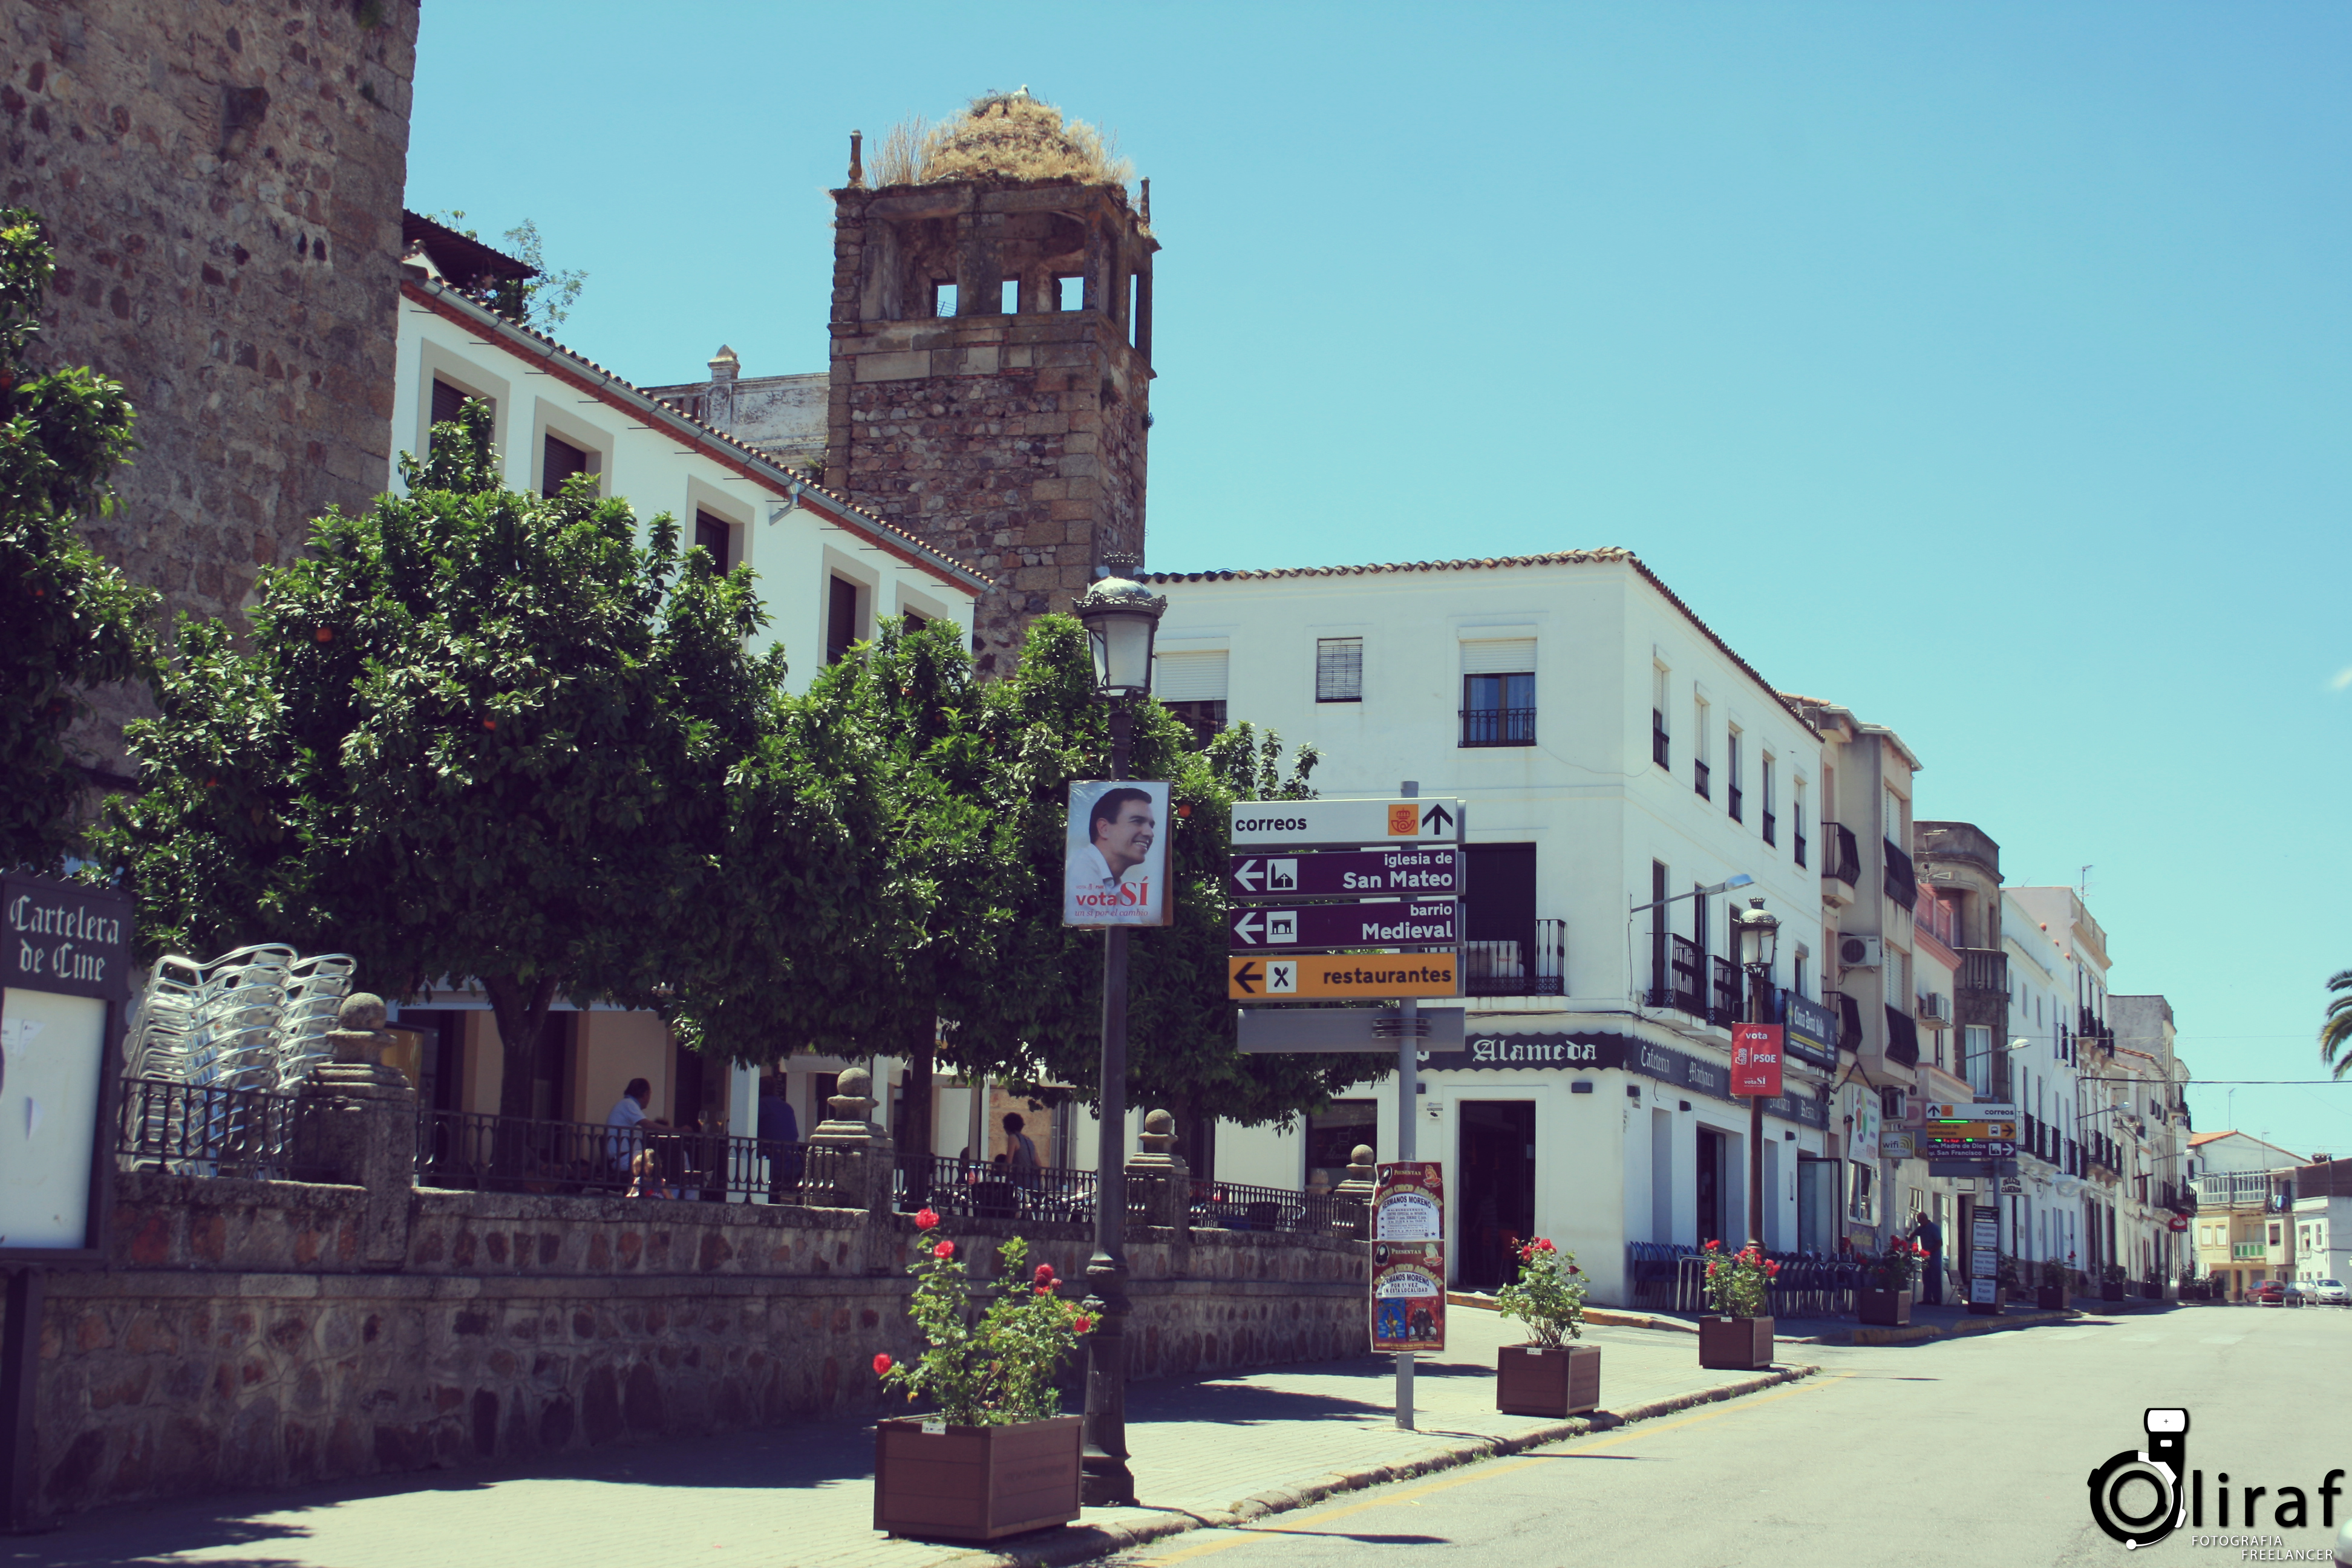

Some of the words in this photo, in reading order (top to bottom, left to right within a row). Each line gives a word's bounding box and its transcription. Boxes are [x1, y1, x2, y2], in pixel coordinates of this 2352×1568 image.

[1235, 817, 1307, 832] correos
[1385, 853, 1431, 868] iglesia
[1435, 852, 1452, 864] de
[1342, 872, 1382, 889] San
[1390, 870, 1452, 887] Mateo
[1076, 892, 1117, 906] vota
[1120, 876, 1149, 906] SÍ
[1095, 910, 1109, 918] por
[1410, 903, 1452, 916] barrio
[10, 895, 120, 945] Cartelera
[1362, 921, 1452, 940] Medieval
[19, 938, 45, 974] de
[53, 942, 106, 982] Cine
[1324, 966, 1452, 984] restaurantes
[1472, 1039, 1598, 1062] Alameda
[1753, 1054, 1777, 1063] PSOE
